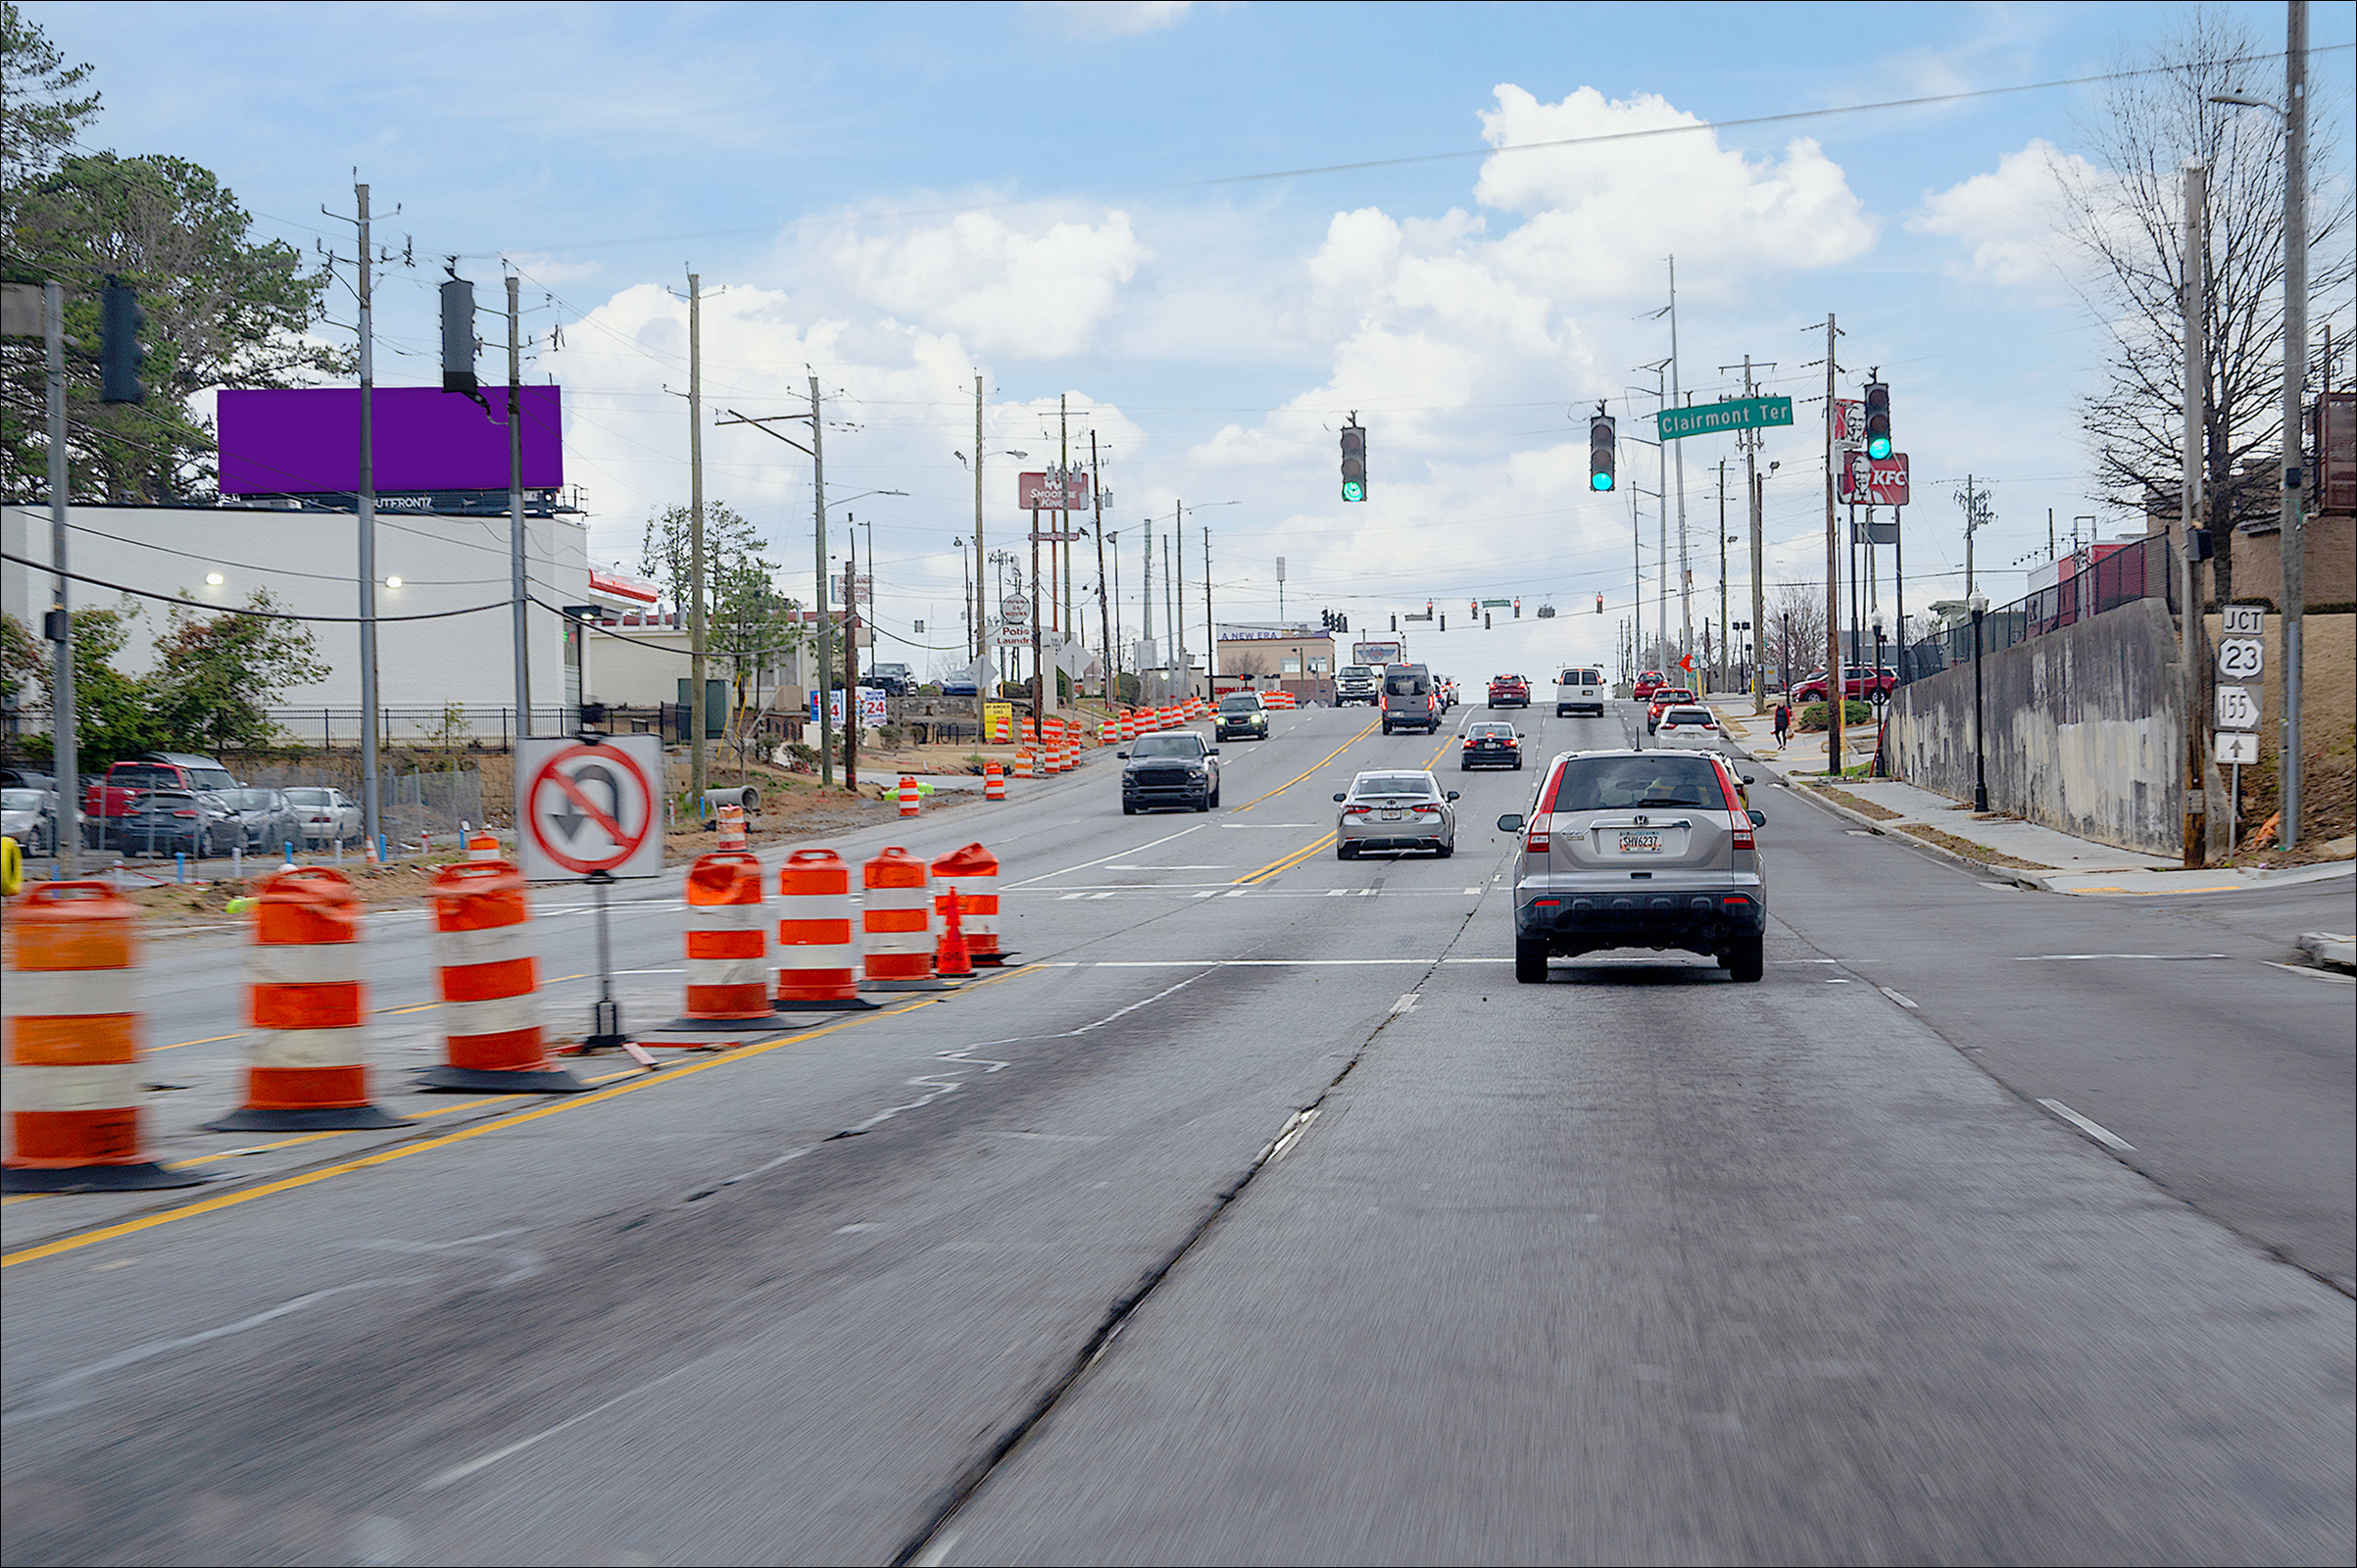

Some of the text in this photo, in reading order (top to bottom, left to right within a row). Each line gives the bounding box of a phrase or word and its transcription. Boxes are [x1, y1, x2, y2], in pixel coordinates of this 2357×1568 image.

[1662, 405, 1788, 433] Clairmont Ter
[1871, 470, 1907, 486] KFC
[2225, 611, 2261, 630] JCT
[1003, 627, 1030, 636] Patio
[1257, 631, 1277, 640] ERA
[2226, 645, 2258, 670] 23
[866, 702, 884, 713] 24
[2221, 694, 2247, 719] 155
